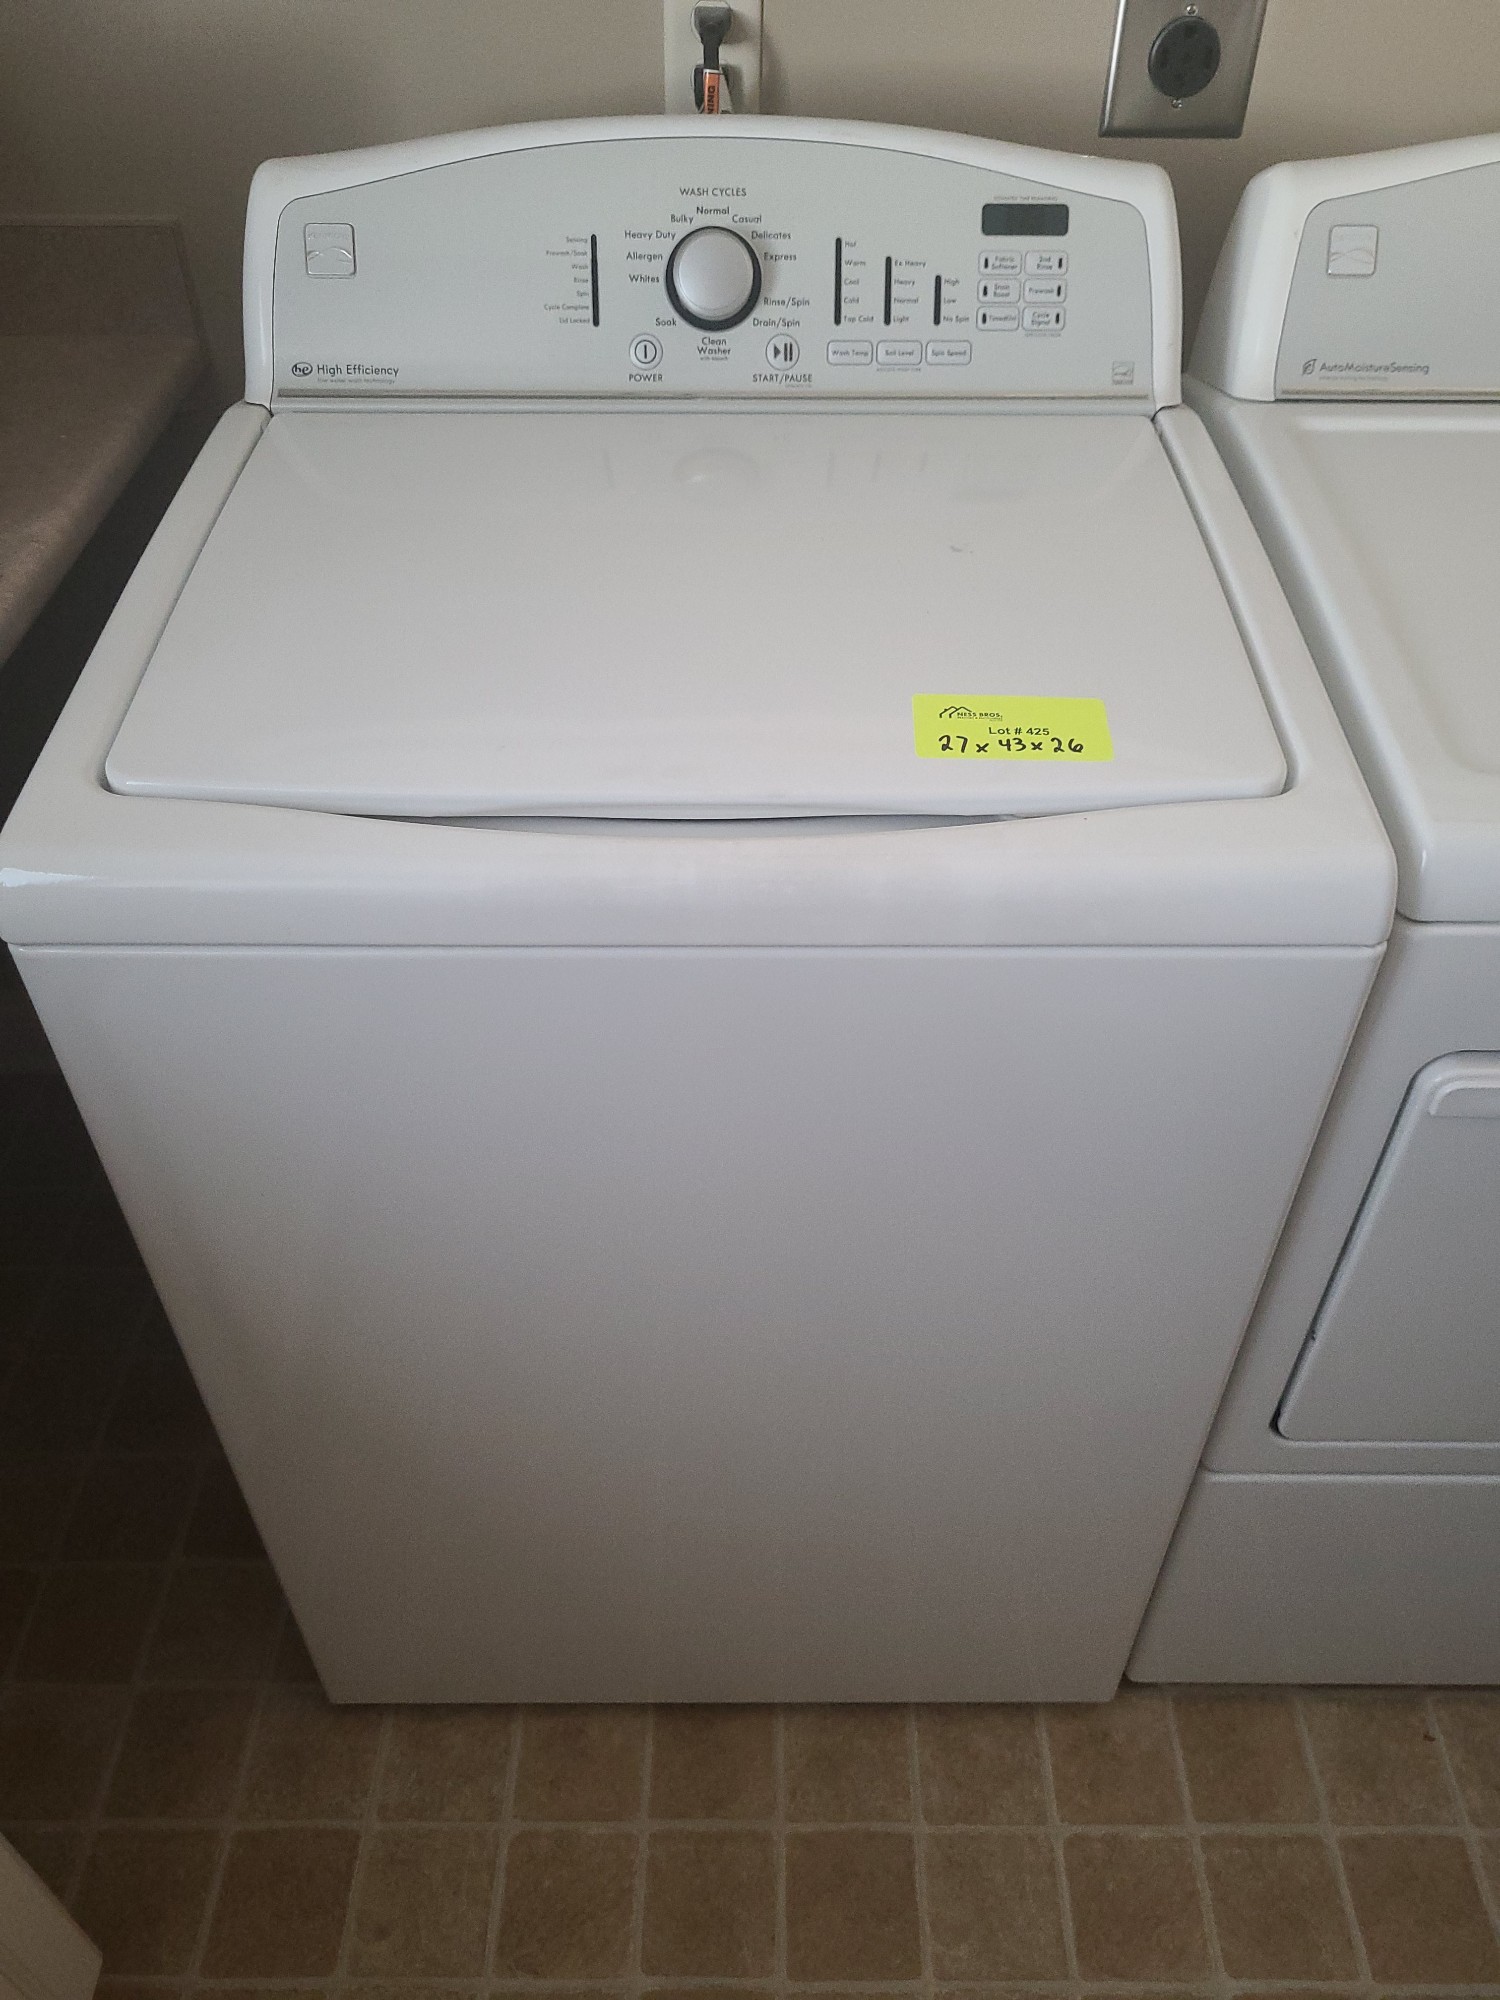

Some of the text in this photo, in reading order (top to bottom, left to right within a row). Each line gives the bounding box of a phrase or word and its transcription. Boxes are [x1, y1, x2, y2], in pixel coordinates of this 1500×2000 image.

[680, 188, 747, 197] WASH CYCLES
[696, 206, 730, 215] Normal
[670, 214, 694, 224] Bulky
[732, 215, 762, 224] Casual
[624, 230, 676, 240] Heavy Duty
[751, 231, 791, 240] Delicates
[626, 252, 663, 262] Allergen
[764, 252, 797, 262] Express
[905, 260, 926, 268] Heavy
[628, 274, 660, 283] Whites
[894, 279, 915, 287] Heavy
[944, 279, 960, 287] High
[763, 297, 810, 307] Rinse/Spin
[655, 318, 677, 327] Soak
[752, 318, 800, 328] Drain/Spin
[858, 315, 874, 323] Cold
[701, 337, 727, 346] Clean
[697, 346, 731, 355] Washer
[317, 364, 343, 377] High
[346, 364, 399, 377] Efficiency
[629, 374, 663, 382] POWER
[752, 374, 812, 383] START/PAUSE
[988, 727, 1050, 736] Lot # 425
[938, 734, 1084, 754] 27 x 43 x 26
